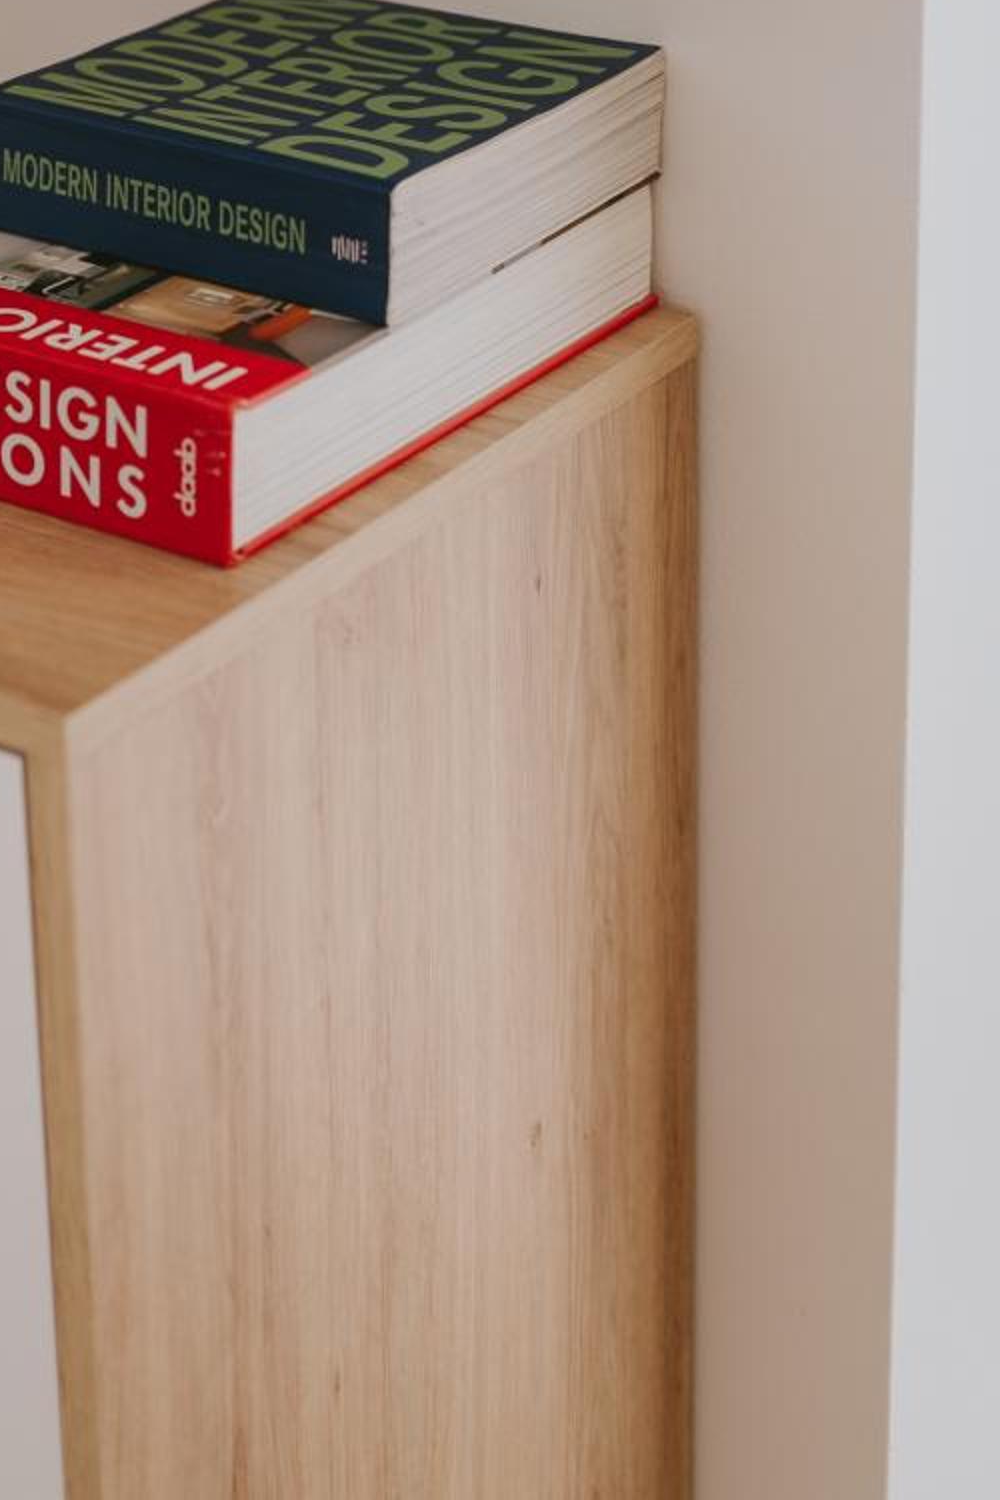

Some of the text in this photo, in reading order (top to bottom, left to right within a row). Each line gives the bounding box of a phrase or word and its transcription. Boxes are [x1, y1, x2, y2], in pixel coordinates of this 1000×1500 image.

[132, 12, 501, 147] INTERIOR
[255, 31, 638, 179] DESIGN
[2, 148, 98, 203] MODERN
[105, 173, 212, 231] INTERIOR
[219, 201, 307, 255] DESIGN
[174, 437, 198, 518] daab
